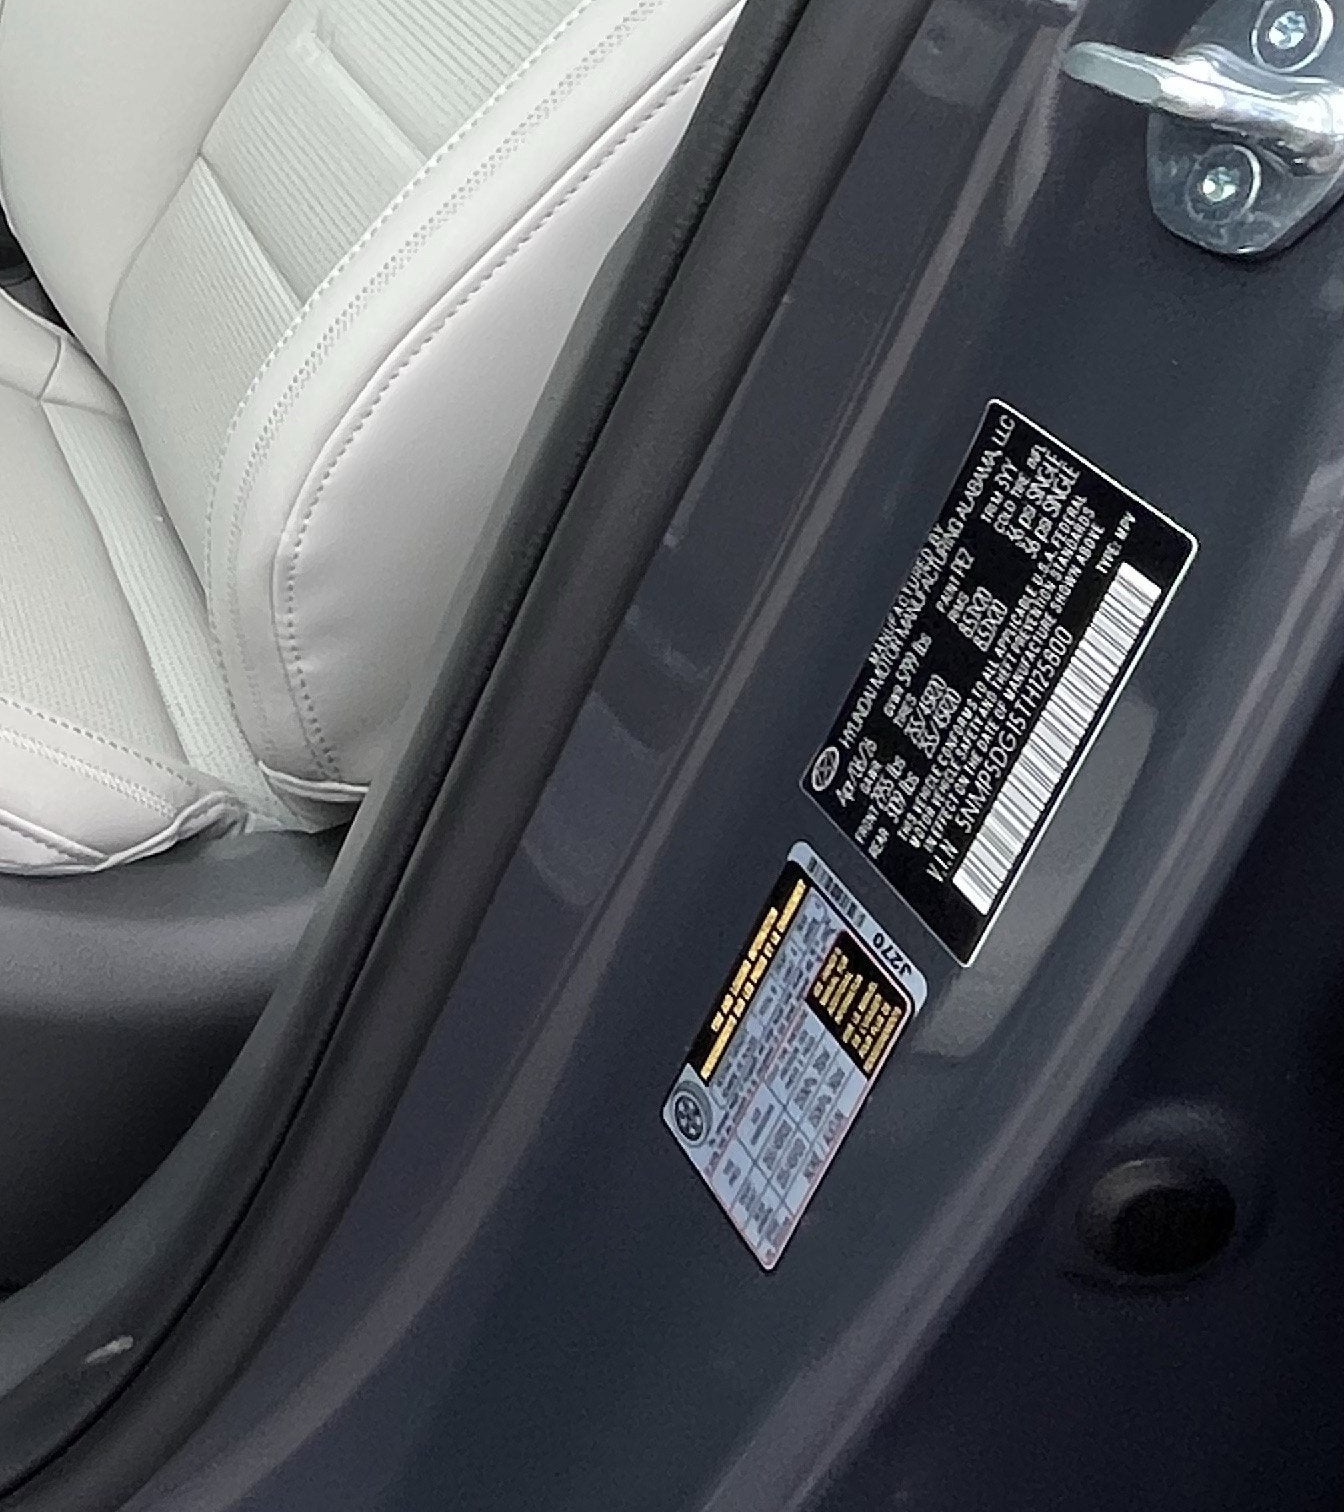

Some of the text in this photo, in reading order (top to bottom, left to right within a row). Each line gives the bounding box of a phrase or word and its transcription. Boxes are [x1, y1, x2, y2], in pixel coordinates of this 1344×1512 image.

[839, 685, 877, 748] HYUNDAI
[870, 634, 903, 689] MOTOR
[895, 518, 963, 637] MANUFACTURING
[991, 415, 1015, 446] LLC
[869, 548, 932, 665] MANUFACTURED
[937, 699, 977, 765] CONFORMS
[971, 681, 987, 699] TO
[982, 660, 999, 682] ALL
[1051, 495, 1087, 548] FEDERAL
[1115, 511, 1135, 540] MPV
[909, 806, 935, 847] MOTOR
[955, 717, 983, 760] SAFETY
[976, 691, 997, 722] AND
[991, 653, 1017, 690] THEFT
[1050, 507, 1094, 580] STANDARDS
[931, 793, 959, 839] EFFECT
[954, 775, 970, 795] ON
[963, 749, 982, 775] THE
[976, 718, 999, 752] DATE
[1004, 612, 1055, 700] MANUFACTURE
[1050, 564, 1081, 613] SHOWN
[1076, 523, 1104, 565] ABOVE
